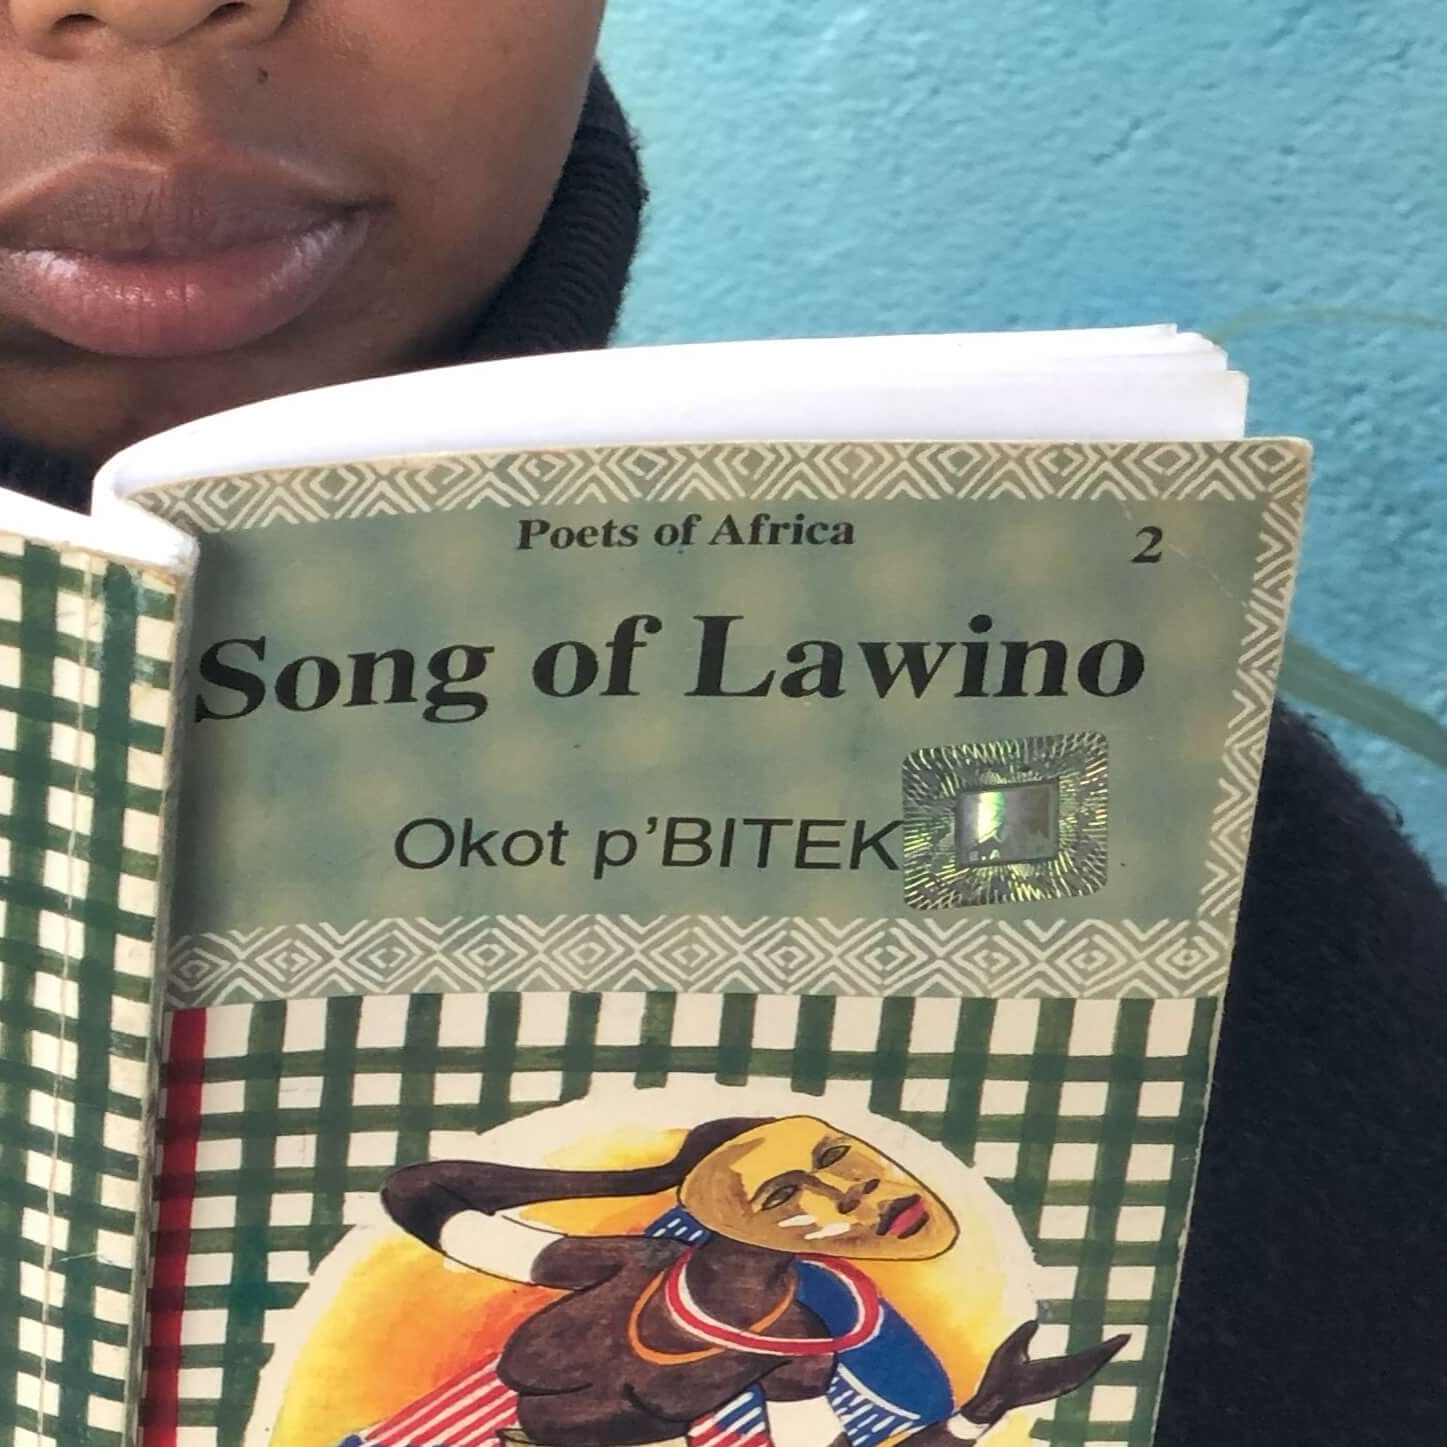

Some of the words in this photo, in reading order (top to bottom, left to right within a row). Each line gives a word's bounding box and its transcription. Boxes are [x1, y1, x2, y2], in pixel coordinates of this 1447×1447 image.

[517, 519, 638, 550] Poets
[654, 514, 702, 546] of
[709, 514, 853, 545] Africa
[1131, 526, 1162, 563] 2
[195, 635, 495, 724] Song
[532, 615, 662, 697] of
[685, 615, 1144, 698] Lawino
[395, 818, 569, 869] Okot
[593, 816, 904, 880] p'BITEK
